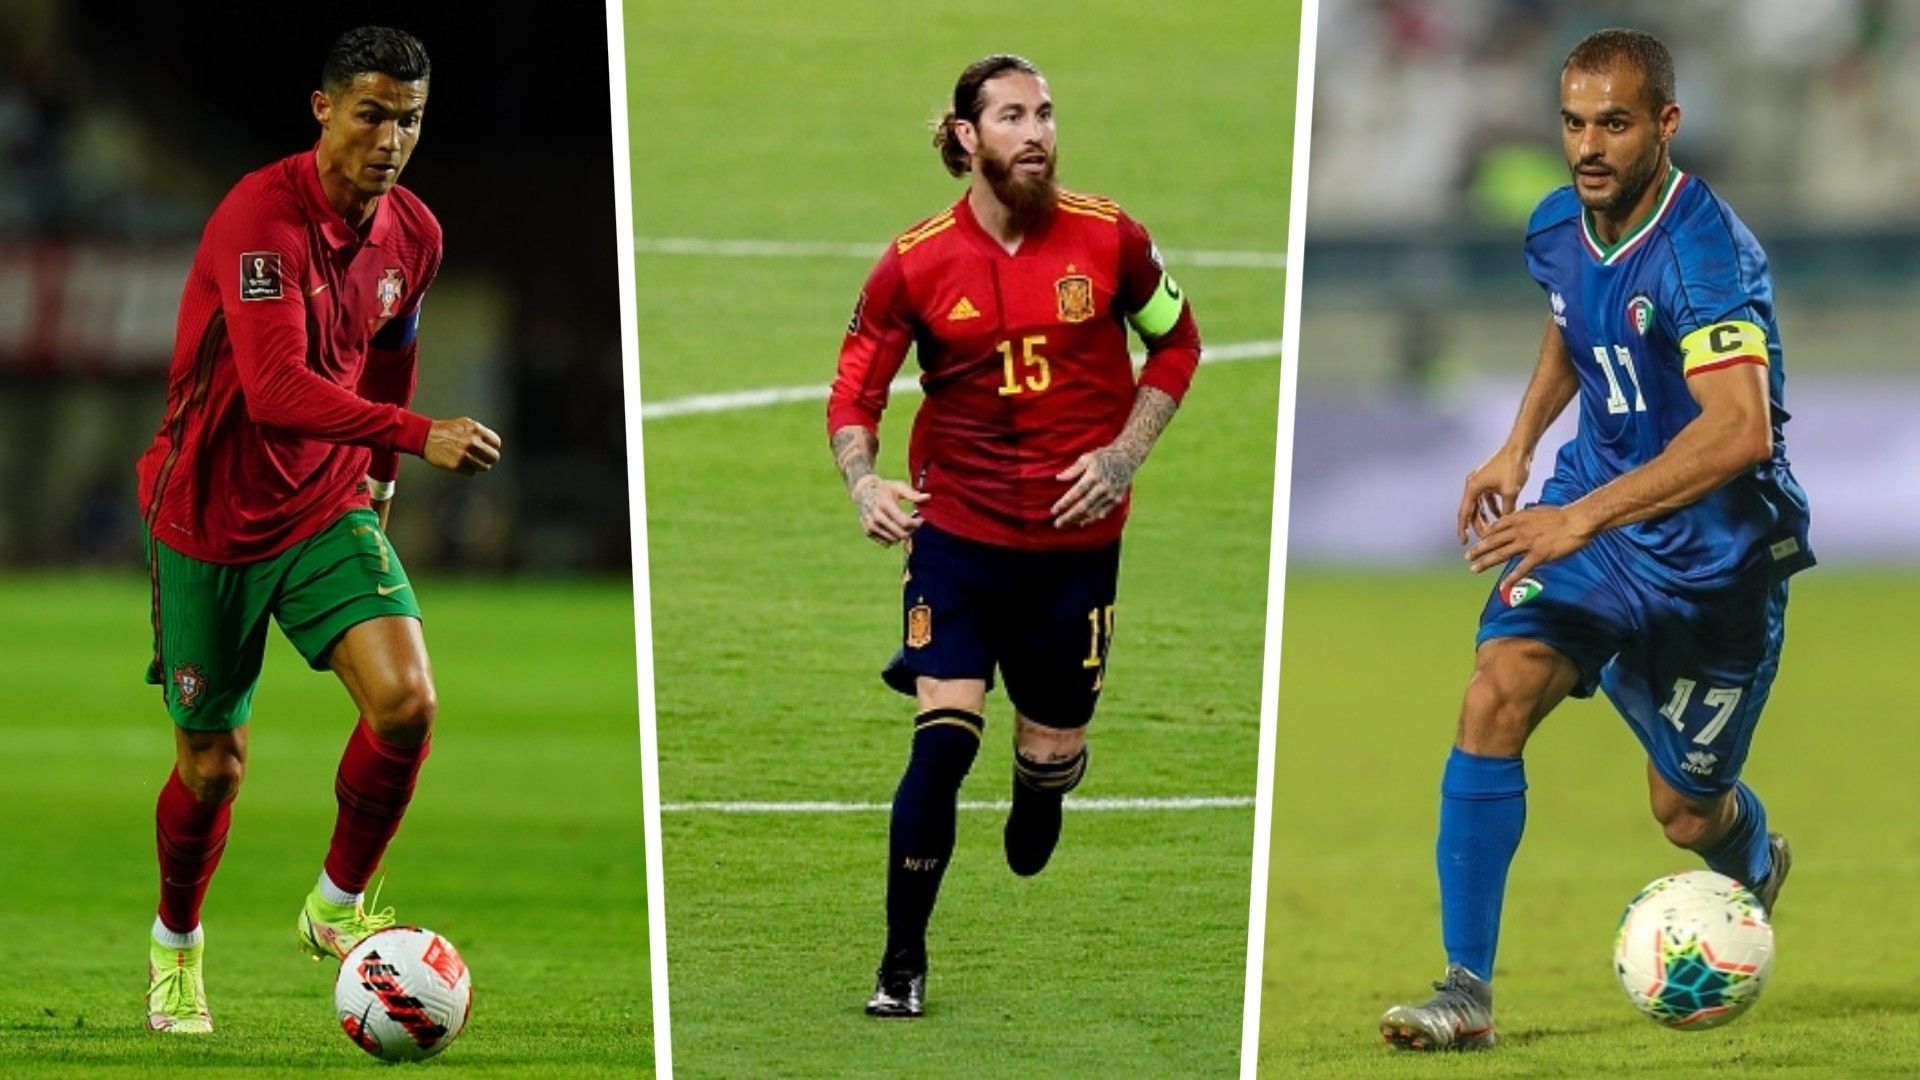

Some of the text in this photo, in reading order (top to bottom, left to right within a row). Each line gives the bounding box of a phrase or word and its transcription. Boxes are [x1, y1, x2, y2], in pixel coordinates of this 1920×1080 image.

[995, 334, 1051, 396] 15
[1709, 325, 1742, 354] C
[352, 525, 390, 574] 7
[1658, 678, 1742, 746] 17
